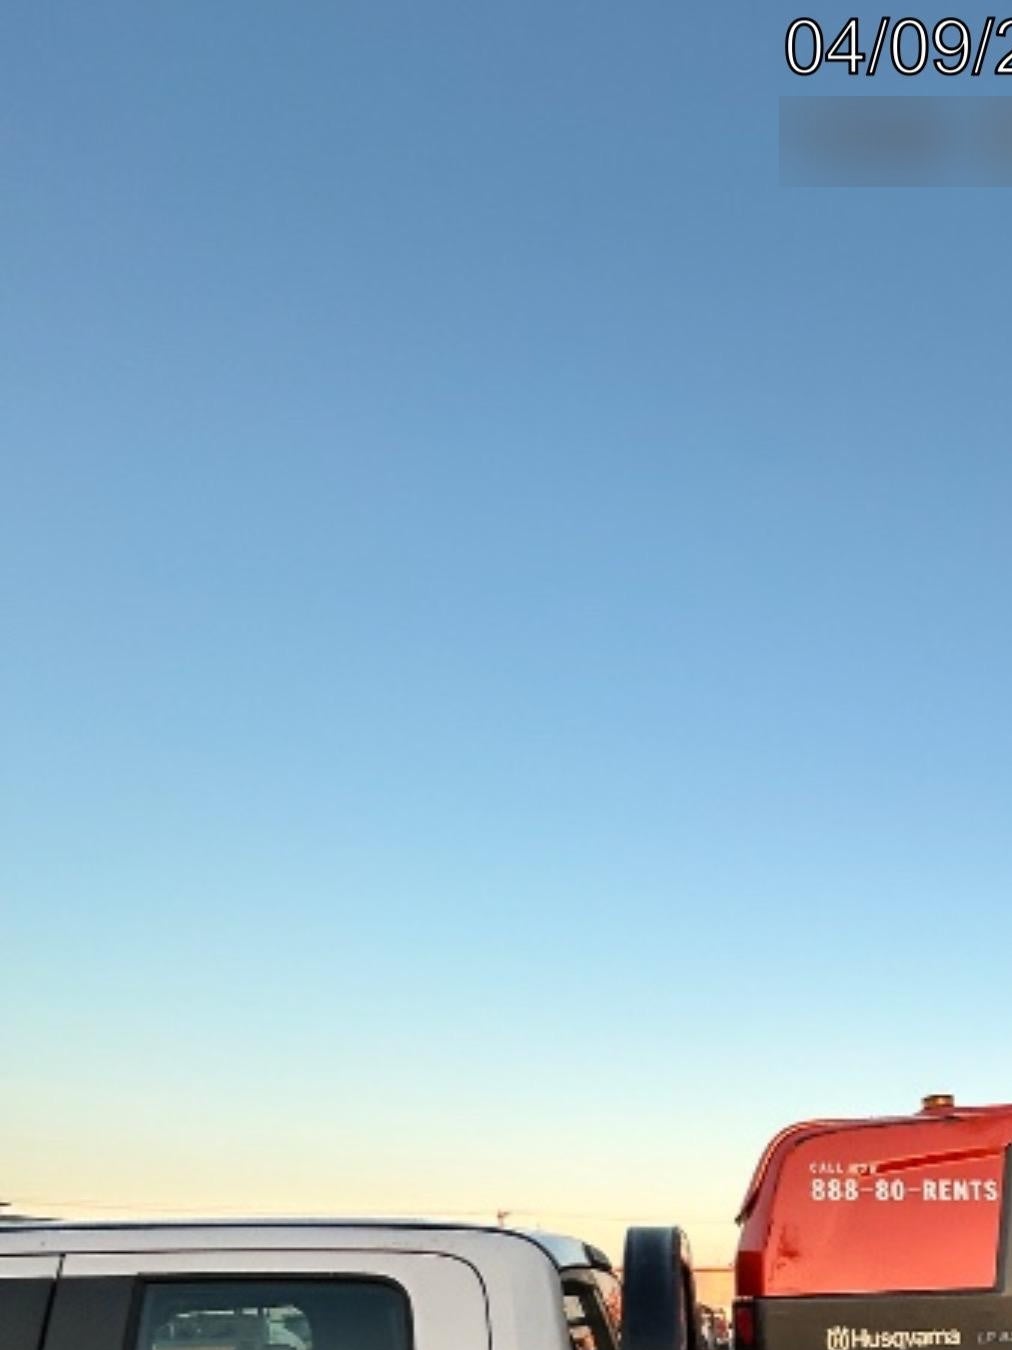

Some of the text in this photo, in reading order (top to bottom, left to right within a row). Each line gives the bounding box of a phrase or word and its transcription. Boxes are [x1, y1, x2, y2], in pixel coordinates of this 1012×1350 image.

[808, 1161, 844, 1174] CALL
[811, 1178, 998, 1201] 888-80-RENTS
[851, 1328, 961, 1349] Husqvarna
